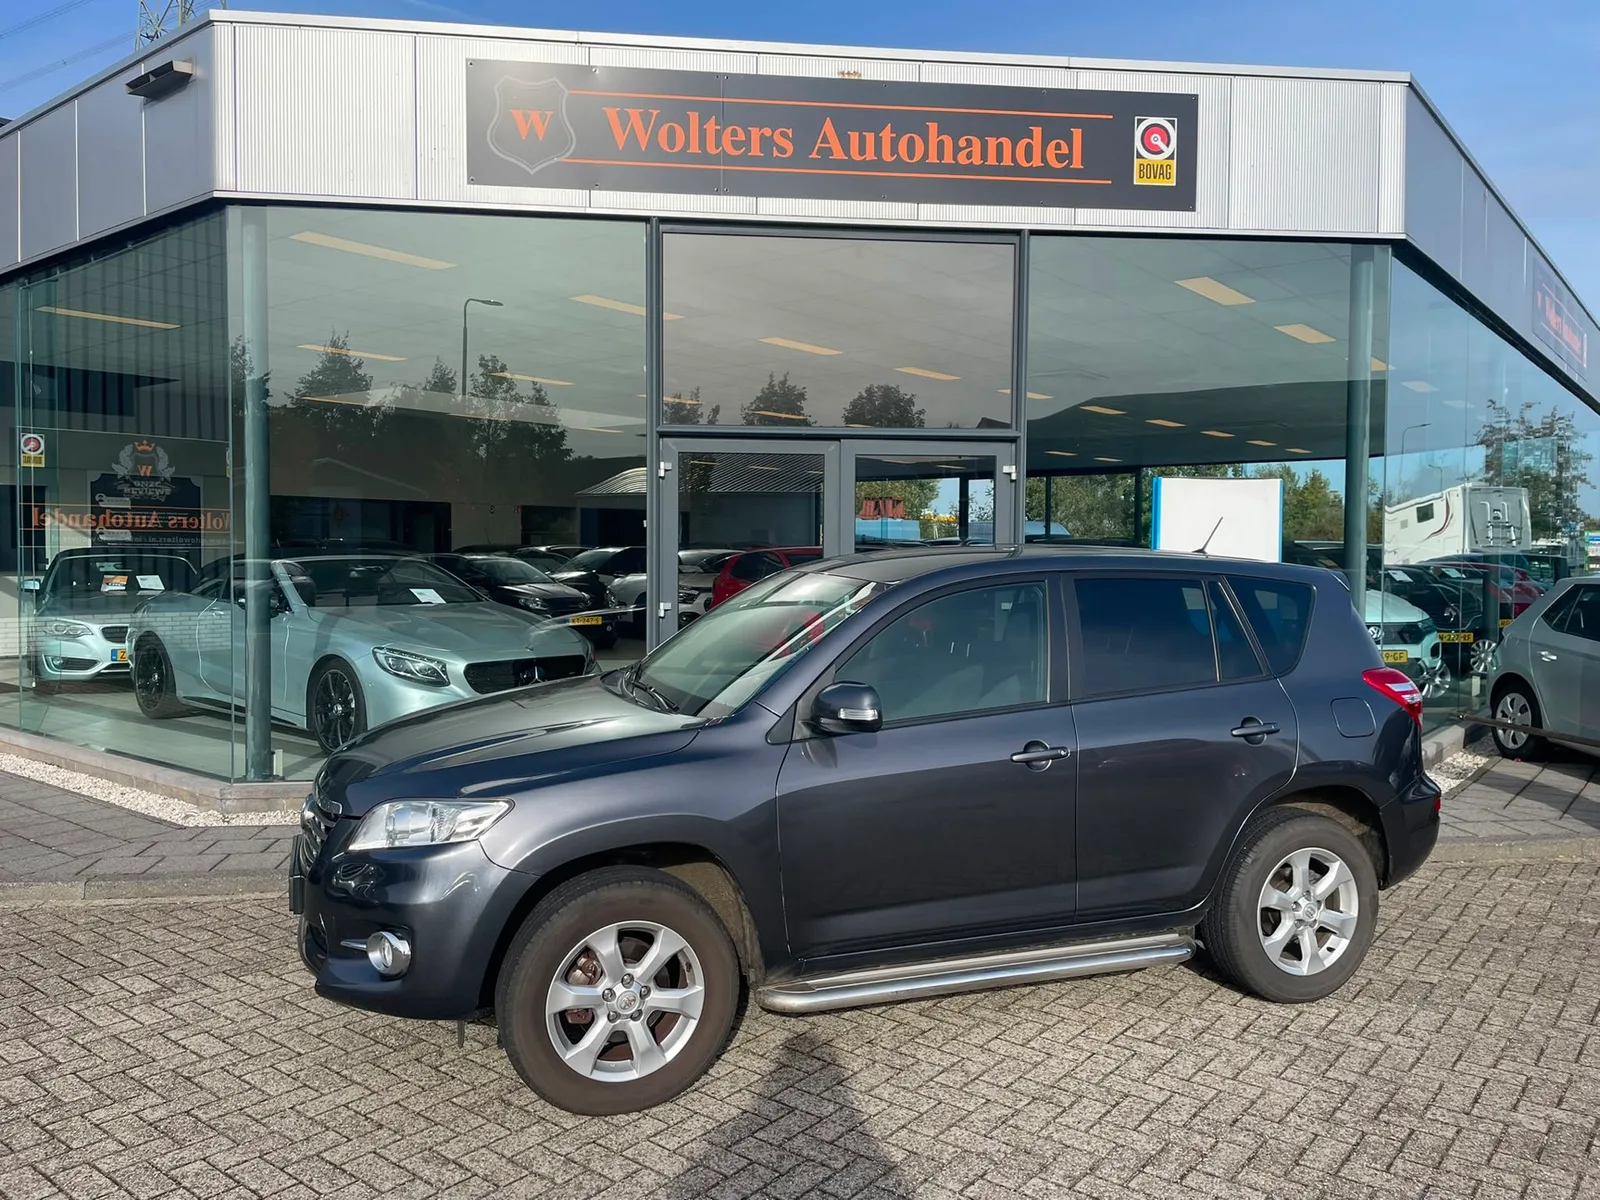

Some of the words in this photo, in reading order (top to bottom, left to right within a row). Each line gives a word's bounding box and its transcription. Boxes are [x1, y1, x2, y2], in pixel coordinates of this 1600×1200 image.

[509, 108, 554, 141] W
[602, 107, 794, 159] Wolters
[808, 117, 1085, 169] Autohandel
[1138, 163, 1172, 180] BOVAG
